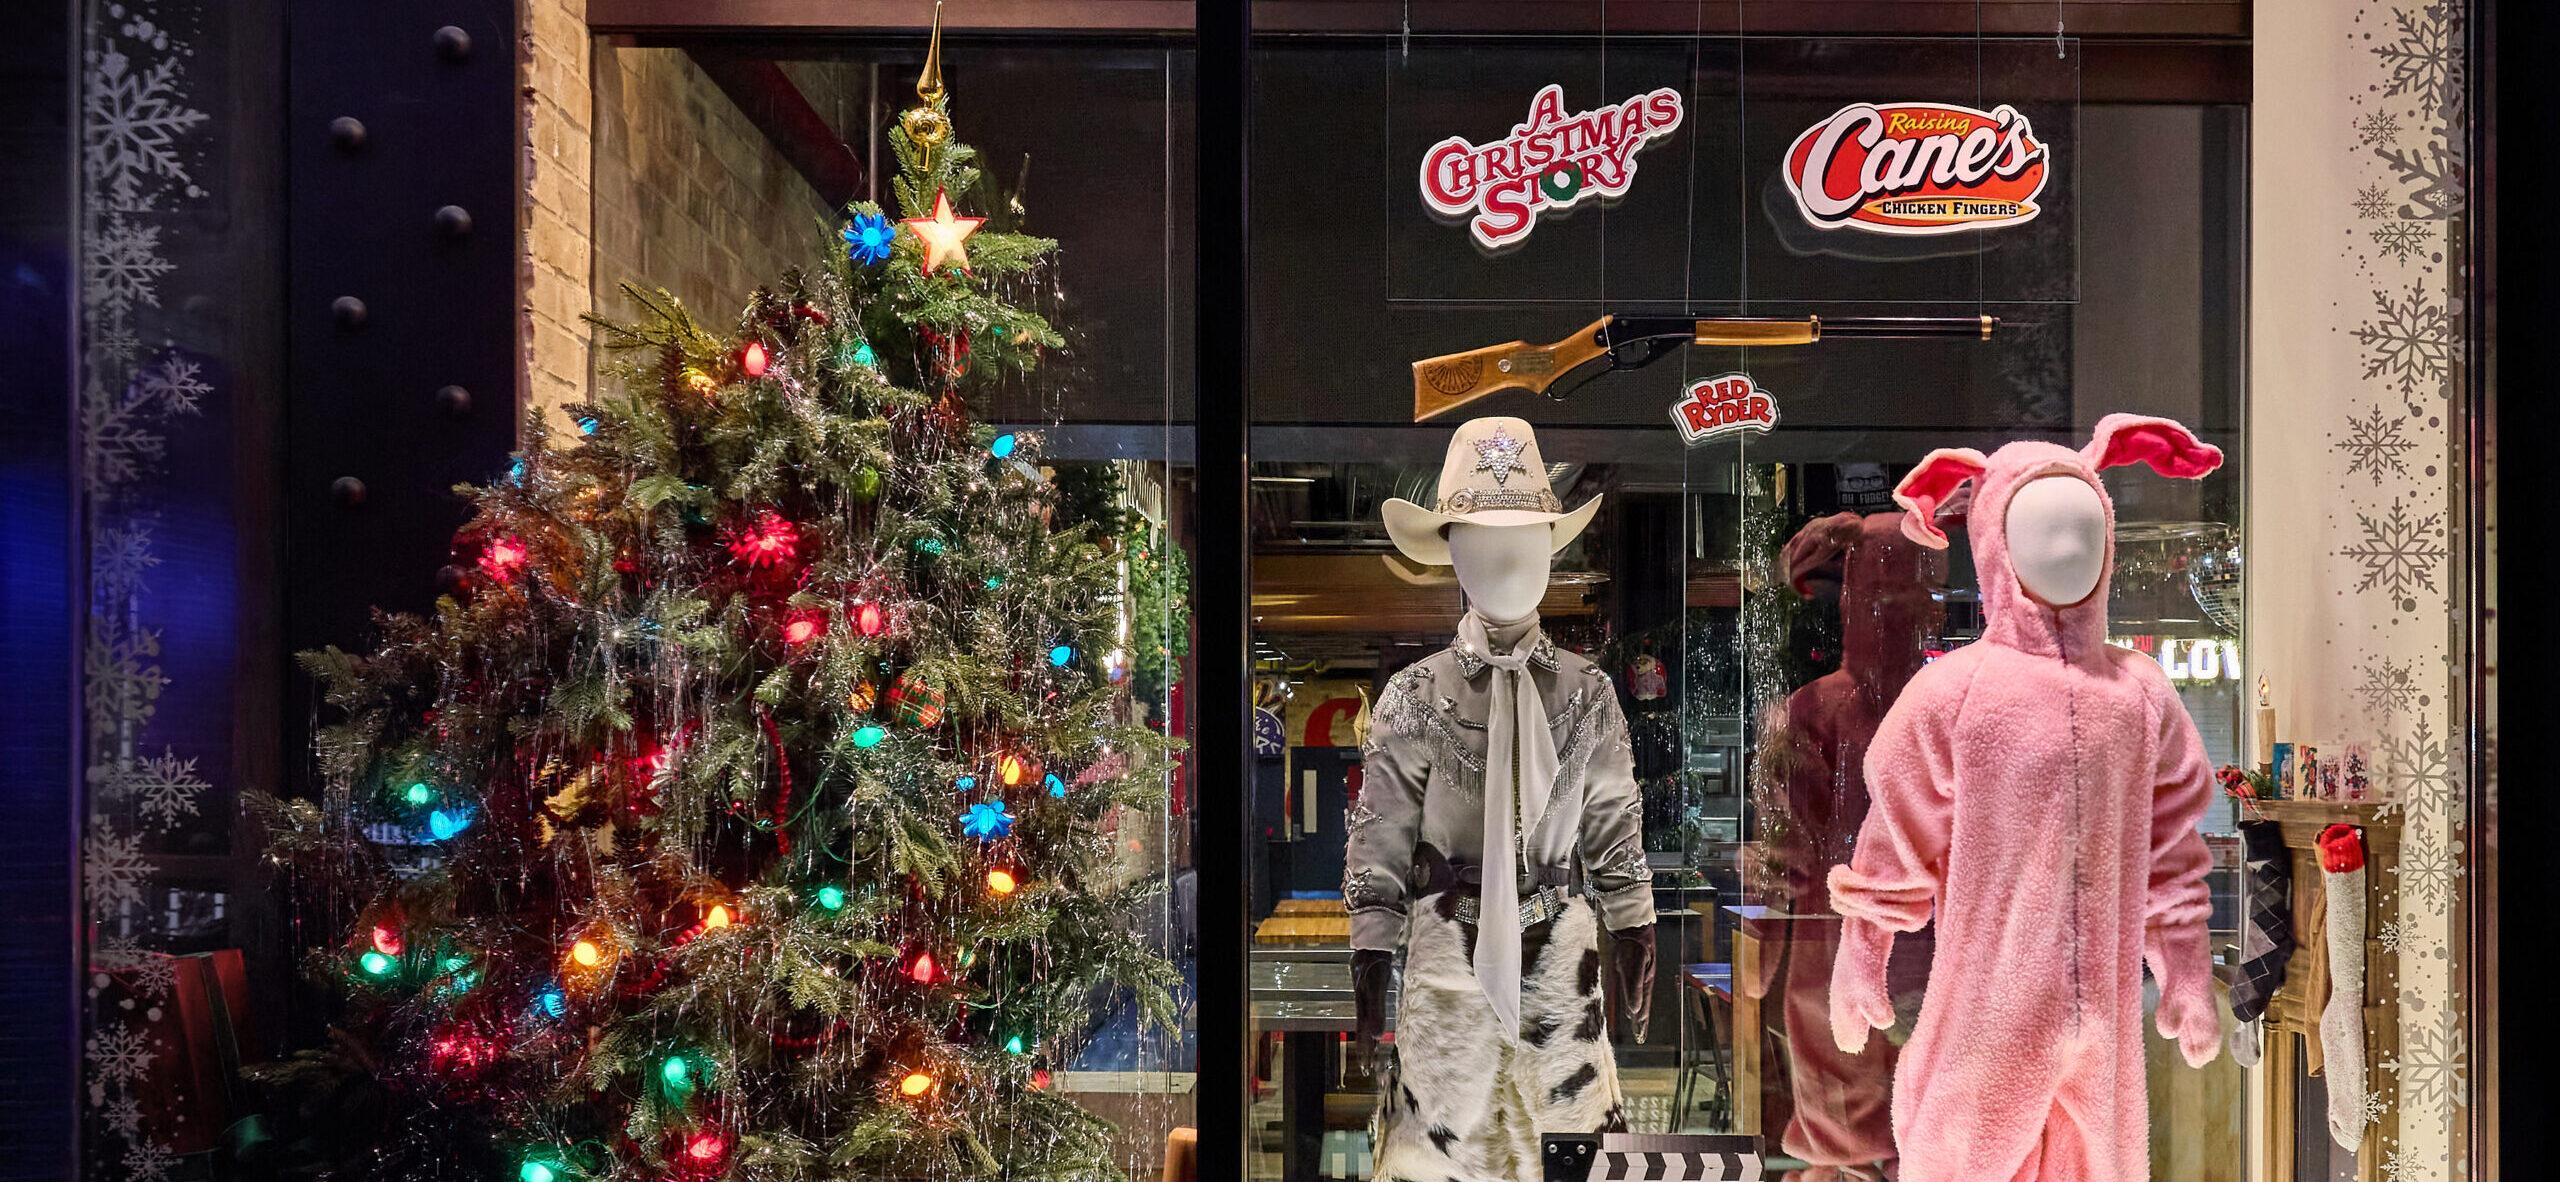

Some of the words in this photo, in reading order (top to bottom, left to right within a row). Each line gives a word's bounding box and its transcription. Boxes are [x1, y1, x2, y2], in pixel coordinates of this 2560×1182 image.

[1518, 91, 1561, 135] A
[1888, 113, 1971, 135] Raising
[1427, 93, 1678, 205] CHRISTMAS
[1801, 106, 2043, 220] Cane's
[1882, 201, 1947, 215] CHICKEN
[1953, 201, 2018, 215] FINGERS
[1695, 380, 1750, 407] RED
[1683, 397, 1772, 433] RYDER
